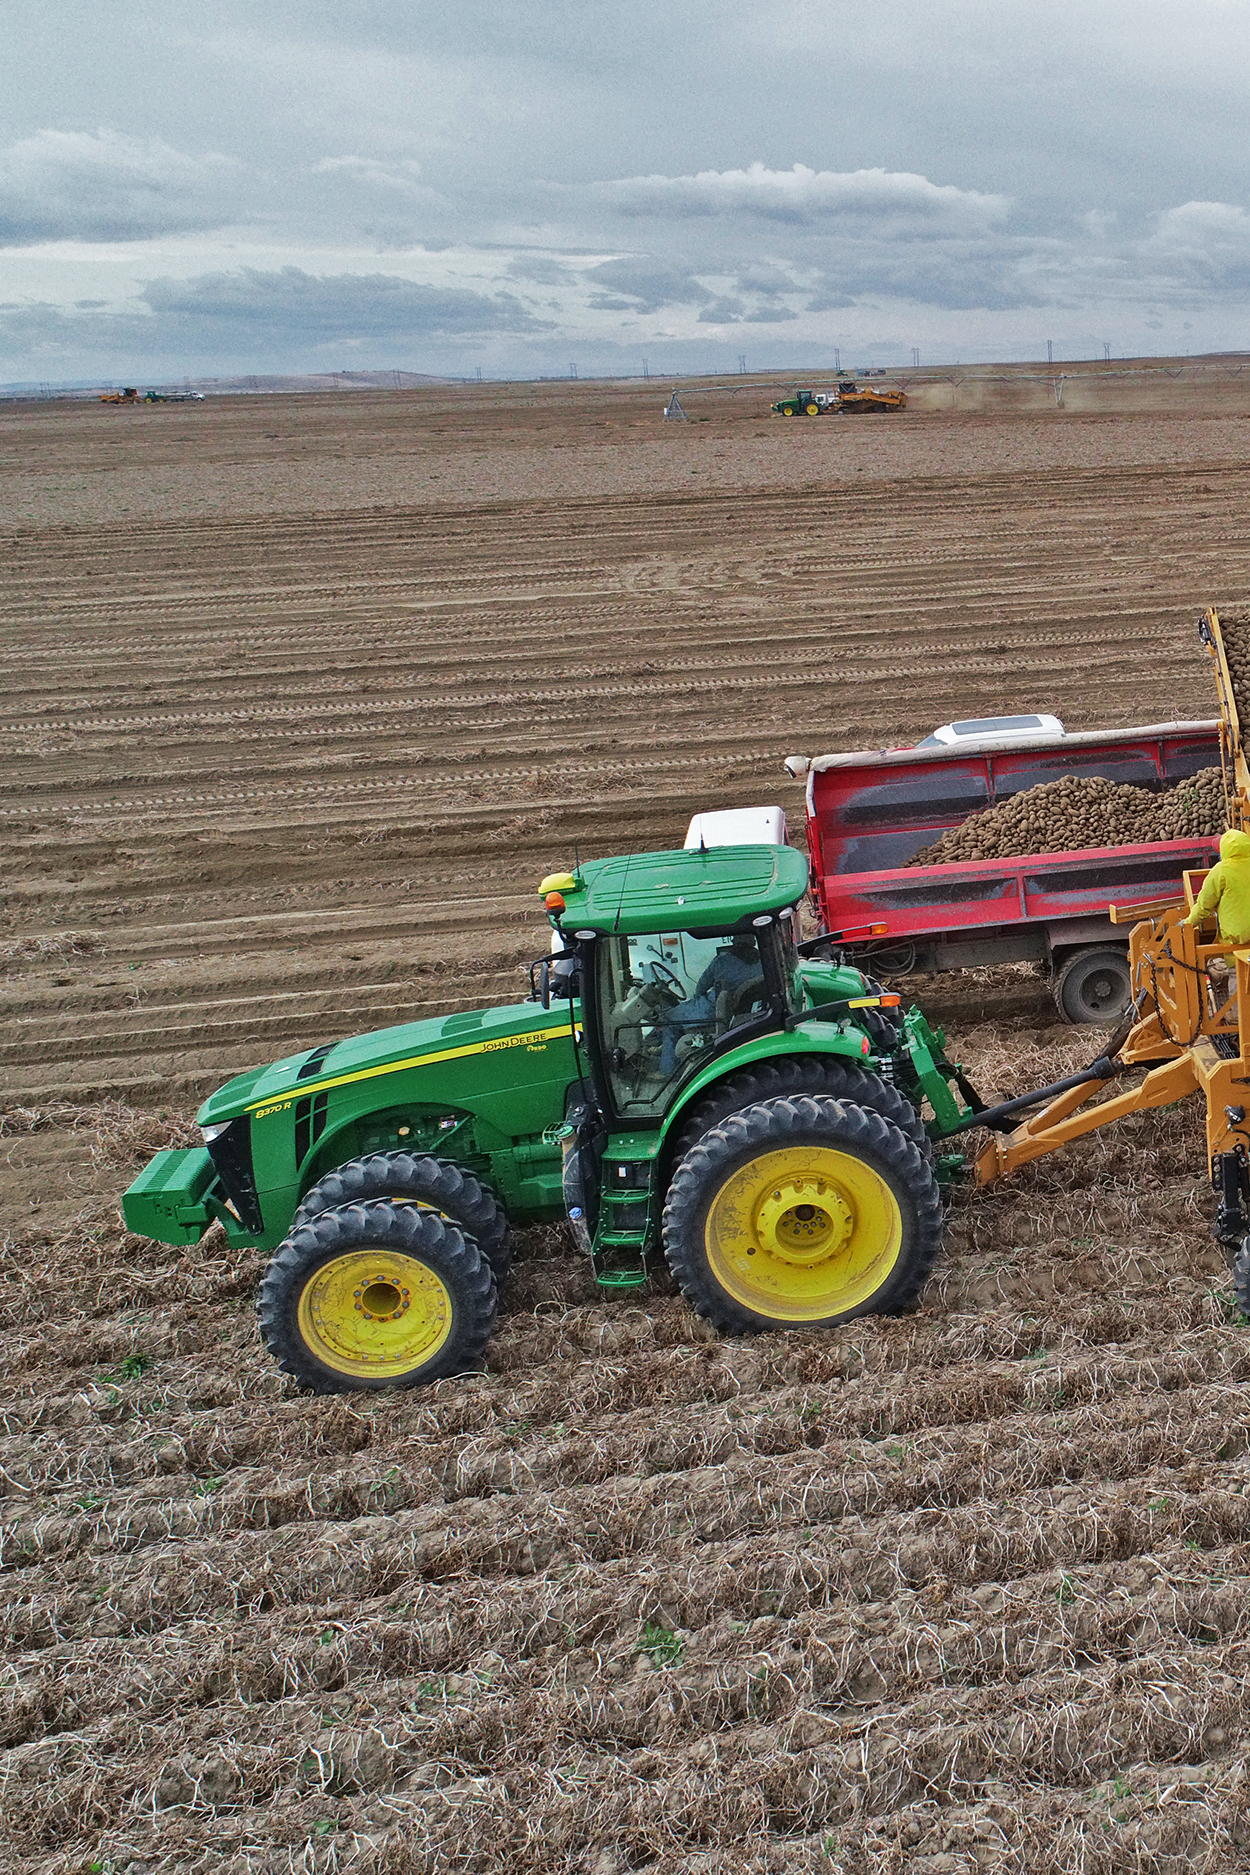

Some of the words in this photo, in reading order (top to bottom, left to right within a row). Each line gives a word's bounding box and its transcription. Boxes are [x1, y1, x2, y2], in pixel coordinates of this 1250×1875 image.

[481, 1040, 510, 1052] JOHN
[510, 1032, 547, 1046] DEERE
[255, 1104, 283, 1119] 8370
